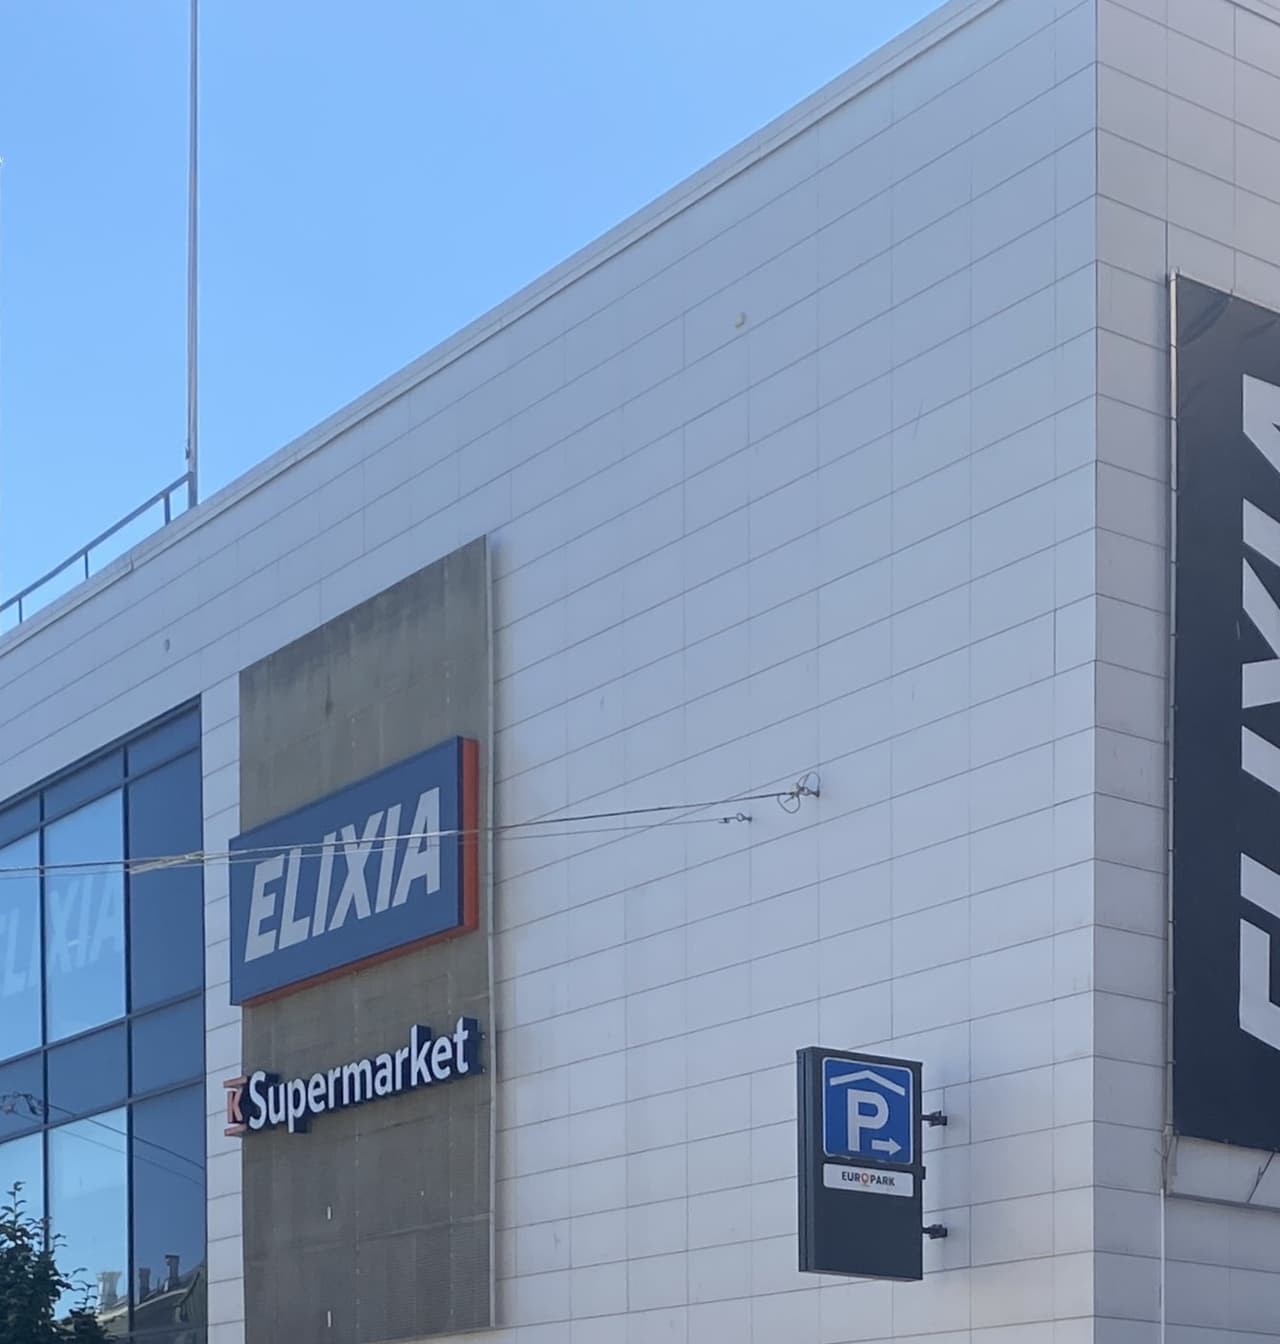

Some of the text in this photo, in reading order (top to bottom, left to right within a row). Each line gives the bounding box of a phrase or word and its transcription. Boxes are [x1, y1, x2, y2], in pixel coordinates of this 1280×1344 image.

[244, 786, 441, 963] ELIXIA
[248, 1016, 471, 1133] Supermarket
[847, 1088, 889, 1152] P
[841, 1170, 895, 1187] EUROPARK
